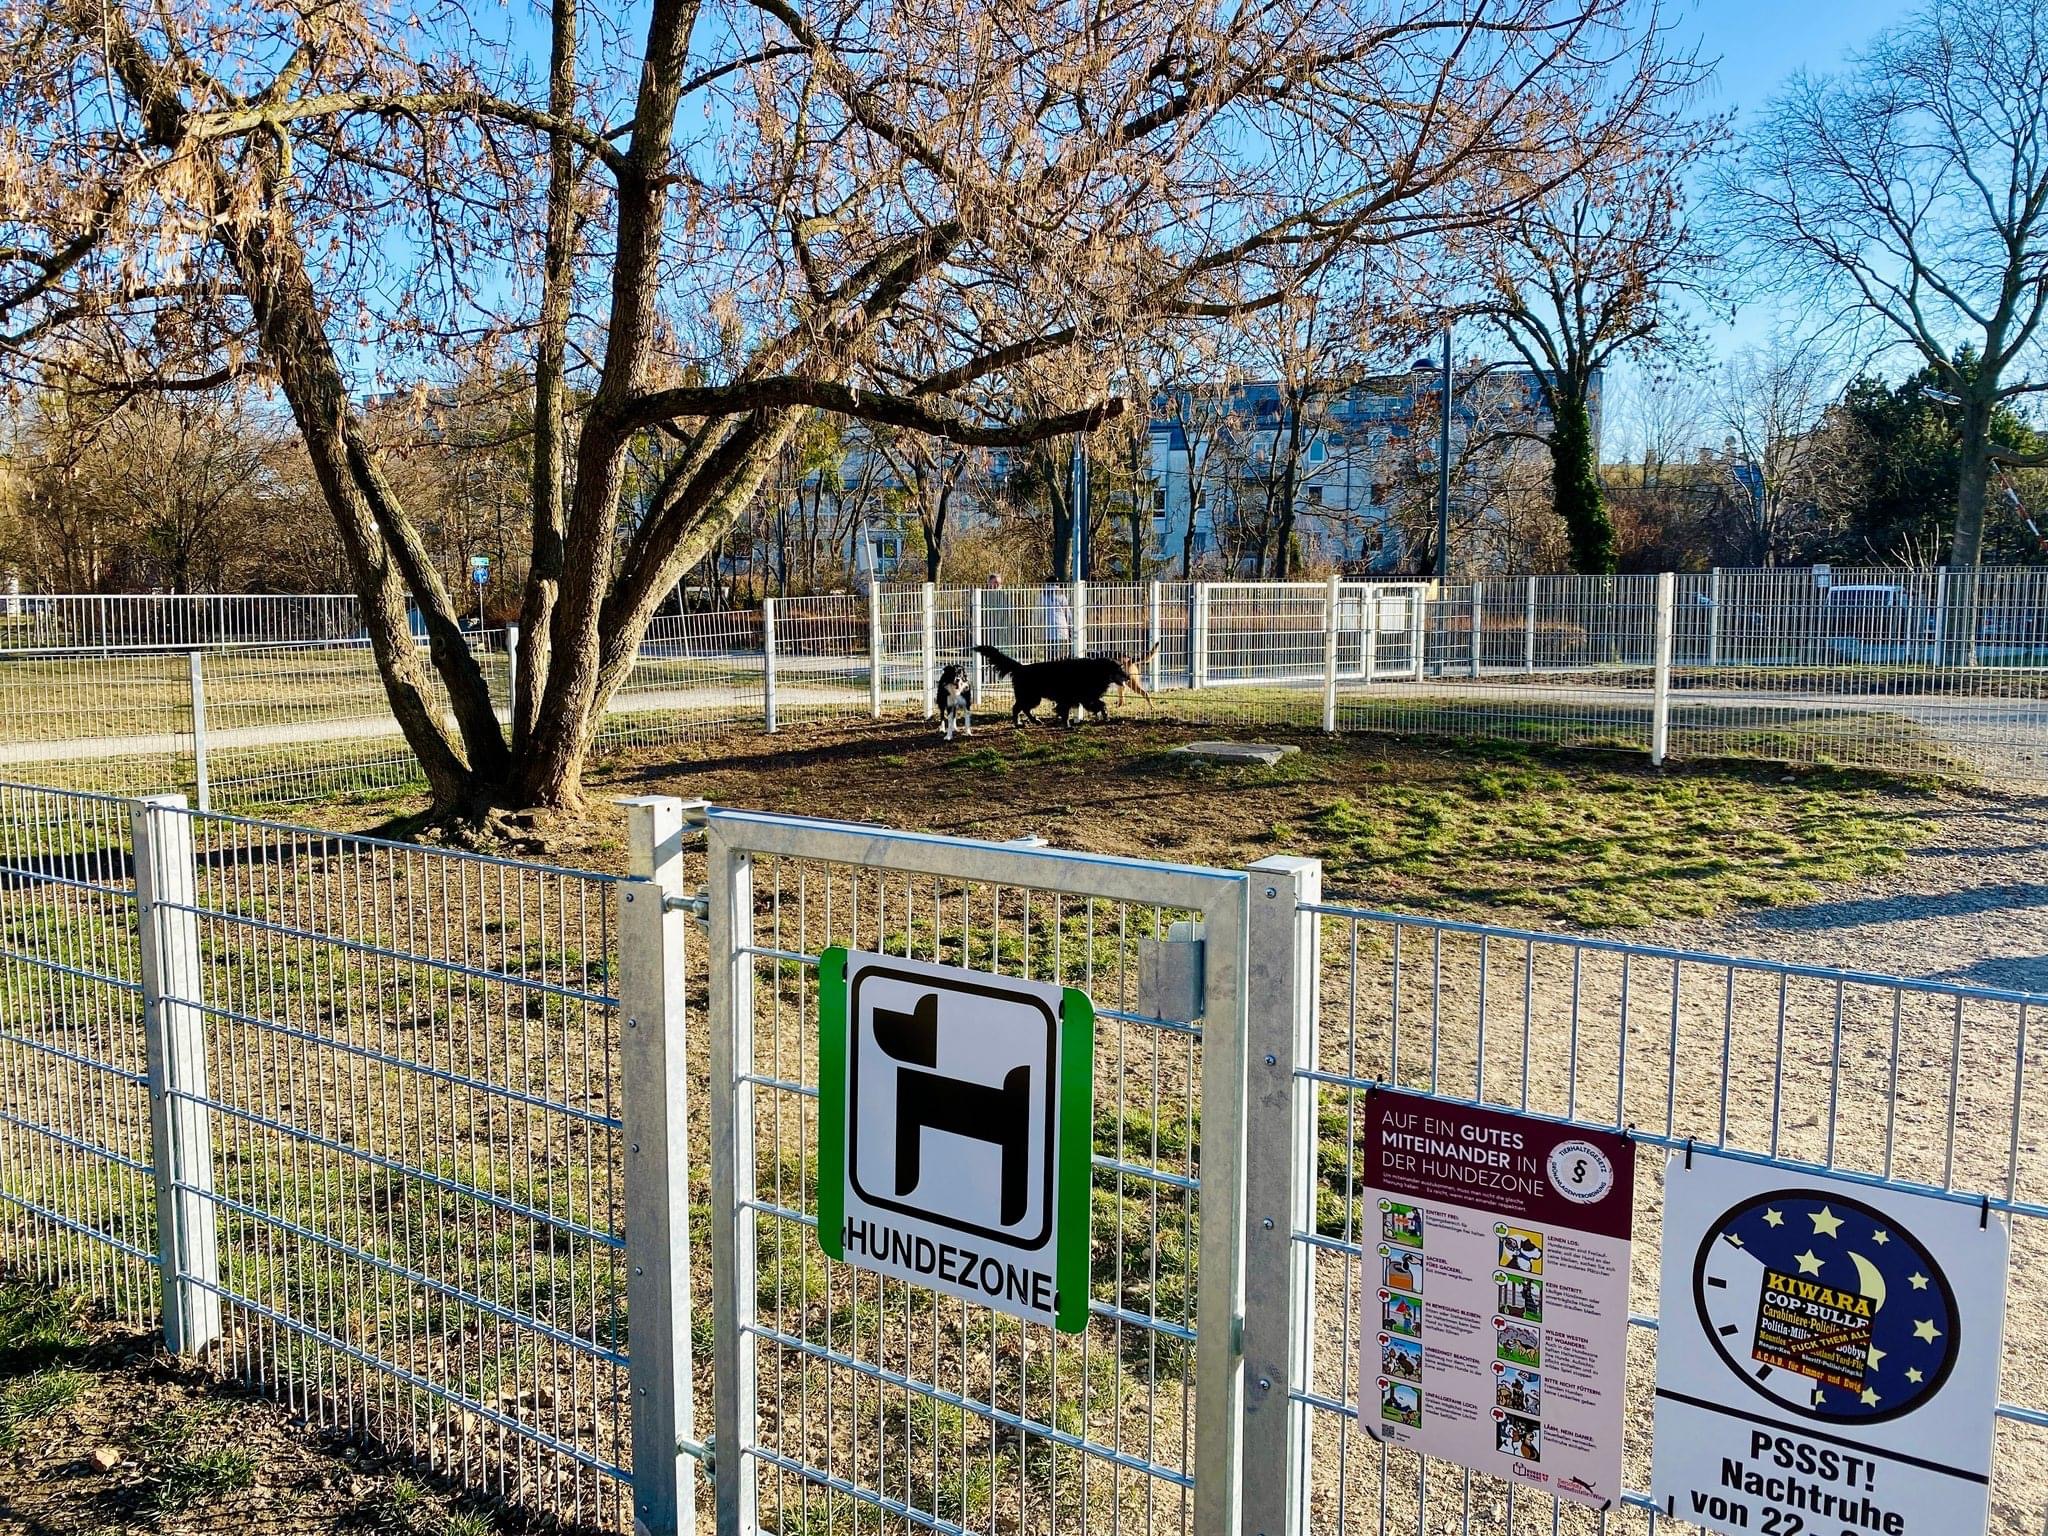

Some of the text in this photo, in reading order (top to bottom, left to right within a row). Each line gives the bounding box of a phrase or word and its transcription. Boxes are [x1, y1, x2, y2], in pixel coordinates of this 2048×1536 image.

[1382, 1110, 1523, 1149] AUF EIN GUTES
[1382, 1129, 1537, 1174] MITEINANDER IN
[1559, 1145, 1607, 1173] TIERHALTEGESETZ
[1382, 1151, 1544, 1197] DER HUNDEZONE
[847, 1215, 1053, 1313] HUNDEZONE
[1768, 1273, 1871, 1316] KIWARA
[1546, 1330, 1588, 1343] WILDER WESTEN
[1792, 1340, 1818, 1353] FUCK
[1819, 1334, 1848, 1346] THEM
[1851, 1330, 1869, 1340] ALL
[1545, 1377, 1558, 1385] BITTE
[1560, 1381, 1575, 1389] NICHT
[1561, 1428, 1573, 1436] NEIN
[1751, 1430, 1875, 1492] PSSST!
[1691, 1490, 1748, 1528] von
[1721, 1457, 1904, 1536] Nachtruhe
